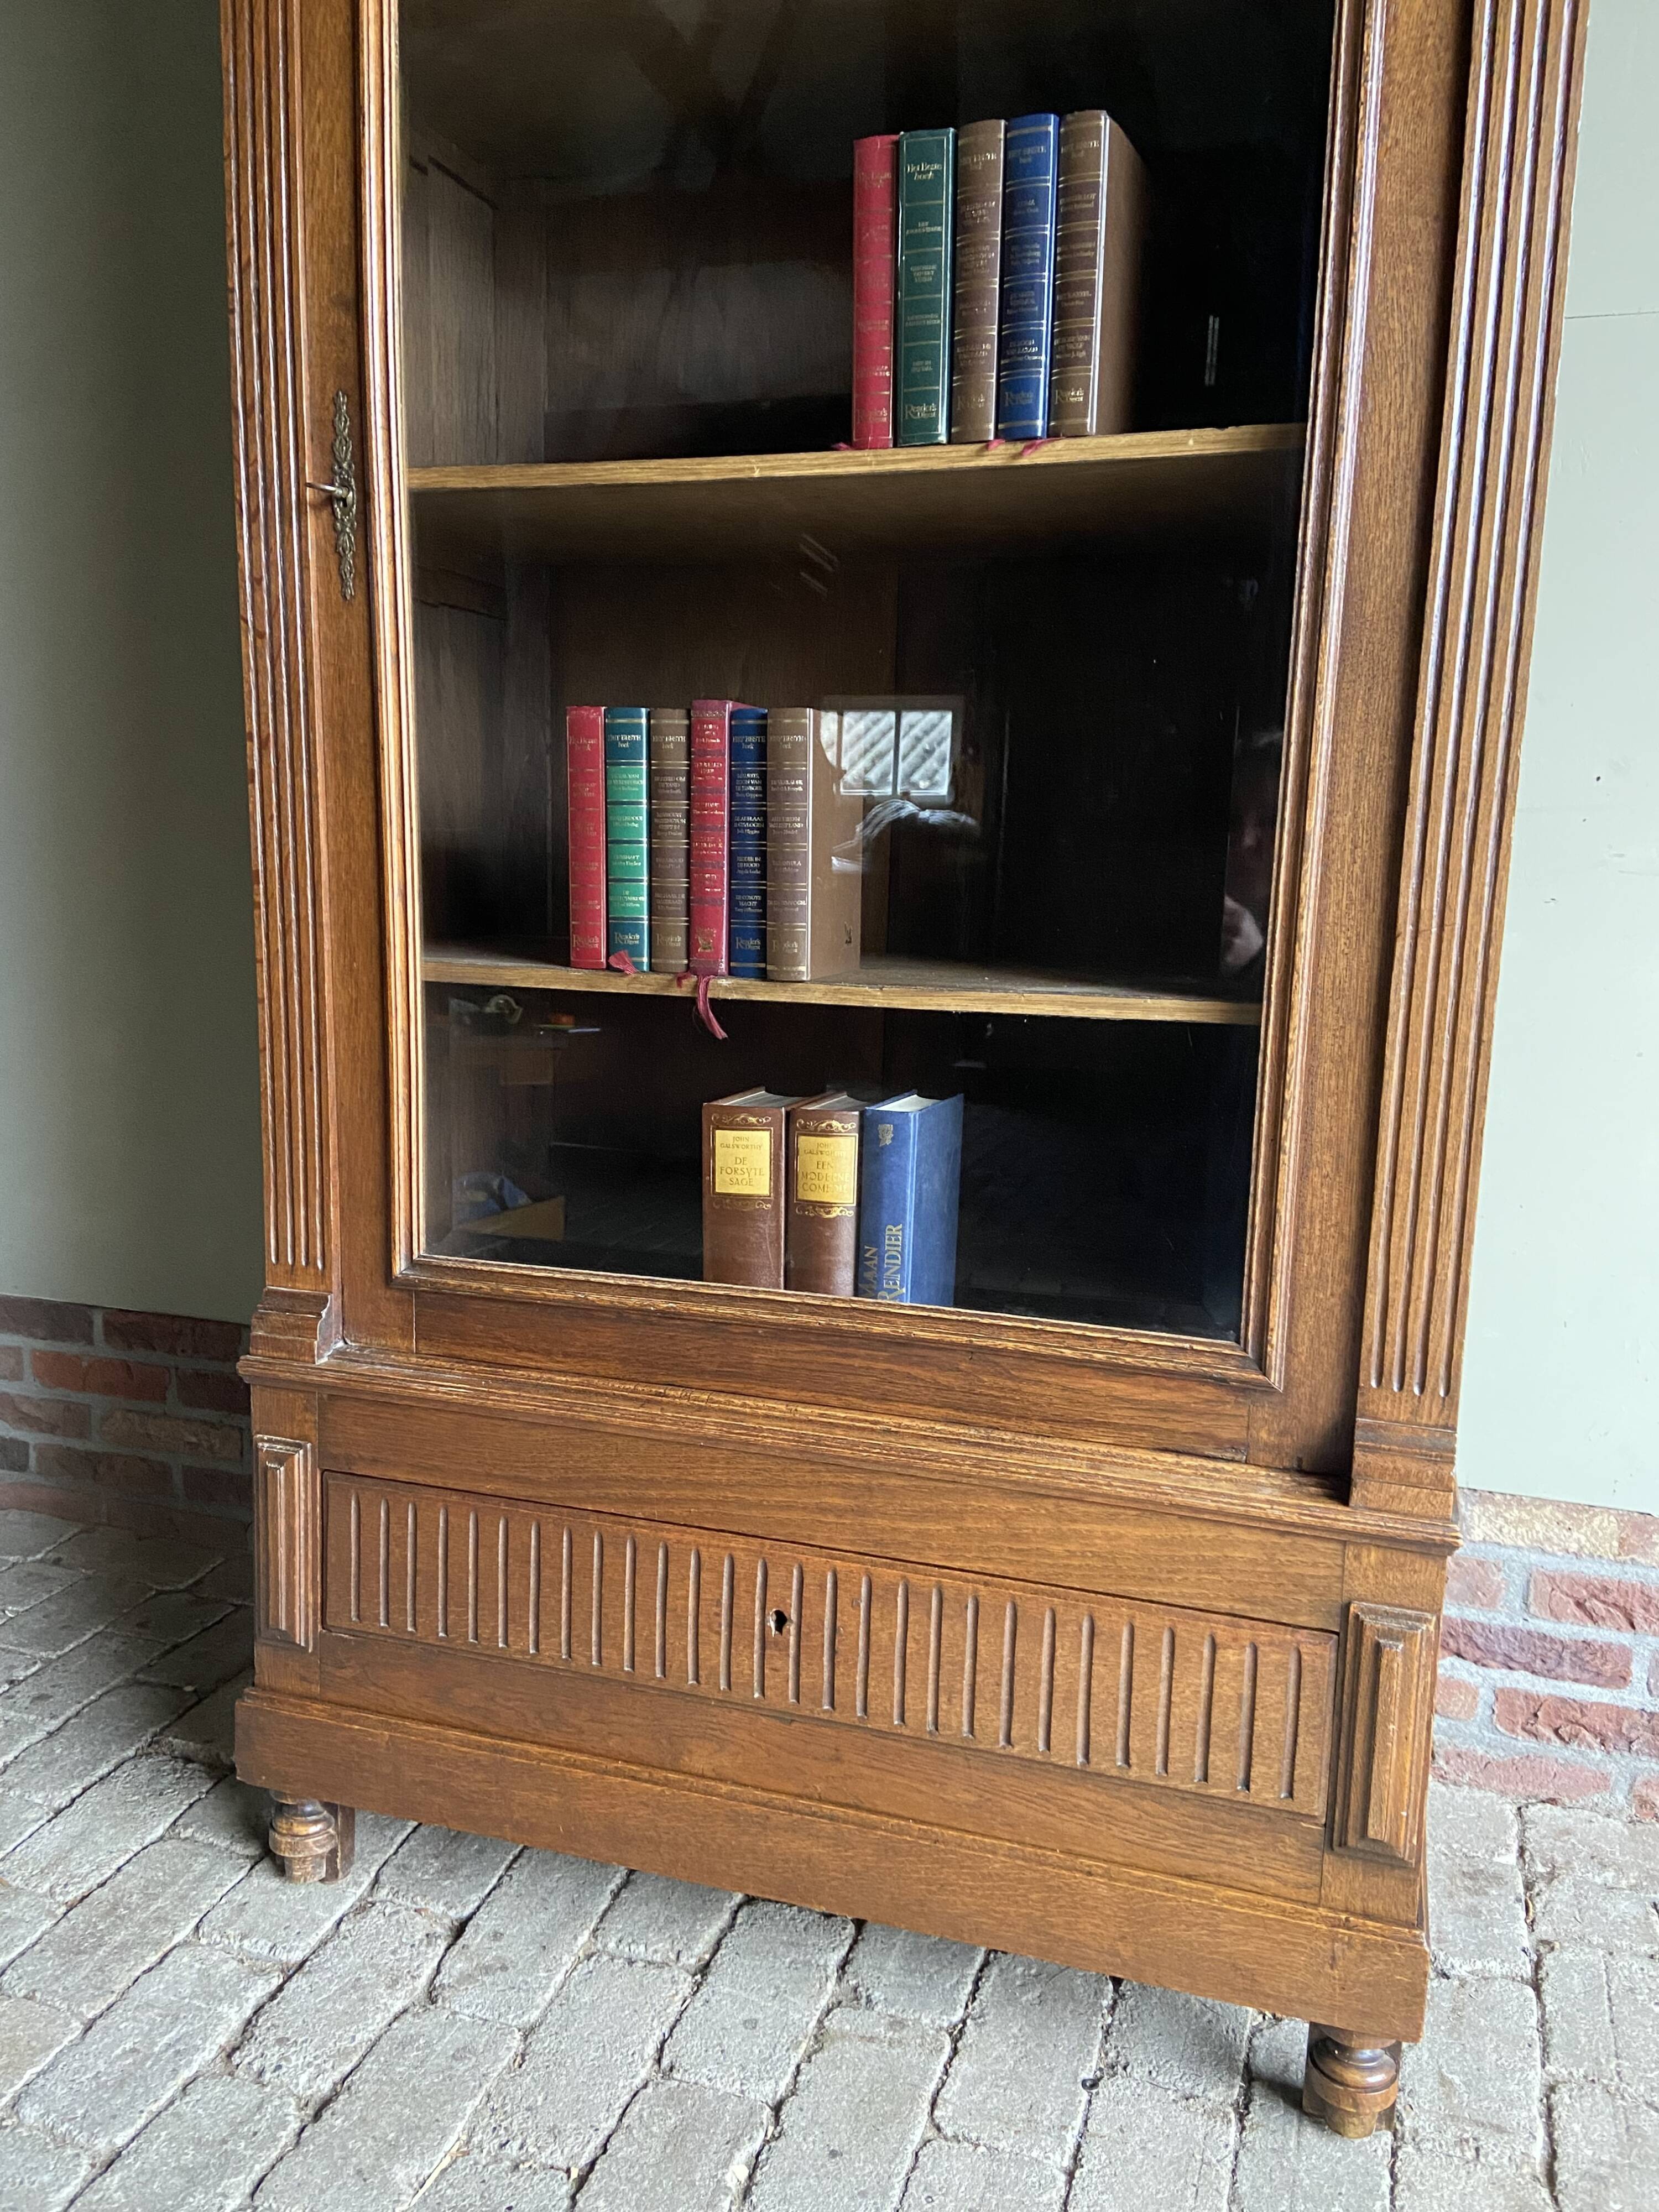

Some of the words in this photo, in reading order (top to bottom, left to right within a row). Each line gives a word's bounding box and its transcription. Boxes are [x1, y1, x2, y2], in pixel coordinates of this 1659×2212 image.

[734, 1156, 748, 1165] DE
[816, 1161, 833, 1170] EEN
[719, 1166, 765, 1178] FORSYTE
[729, 1177, 754, 1186] SAGE
[878, 1223, 905, 1300] RENDIER
